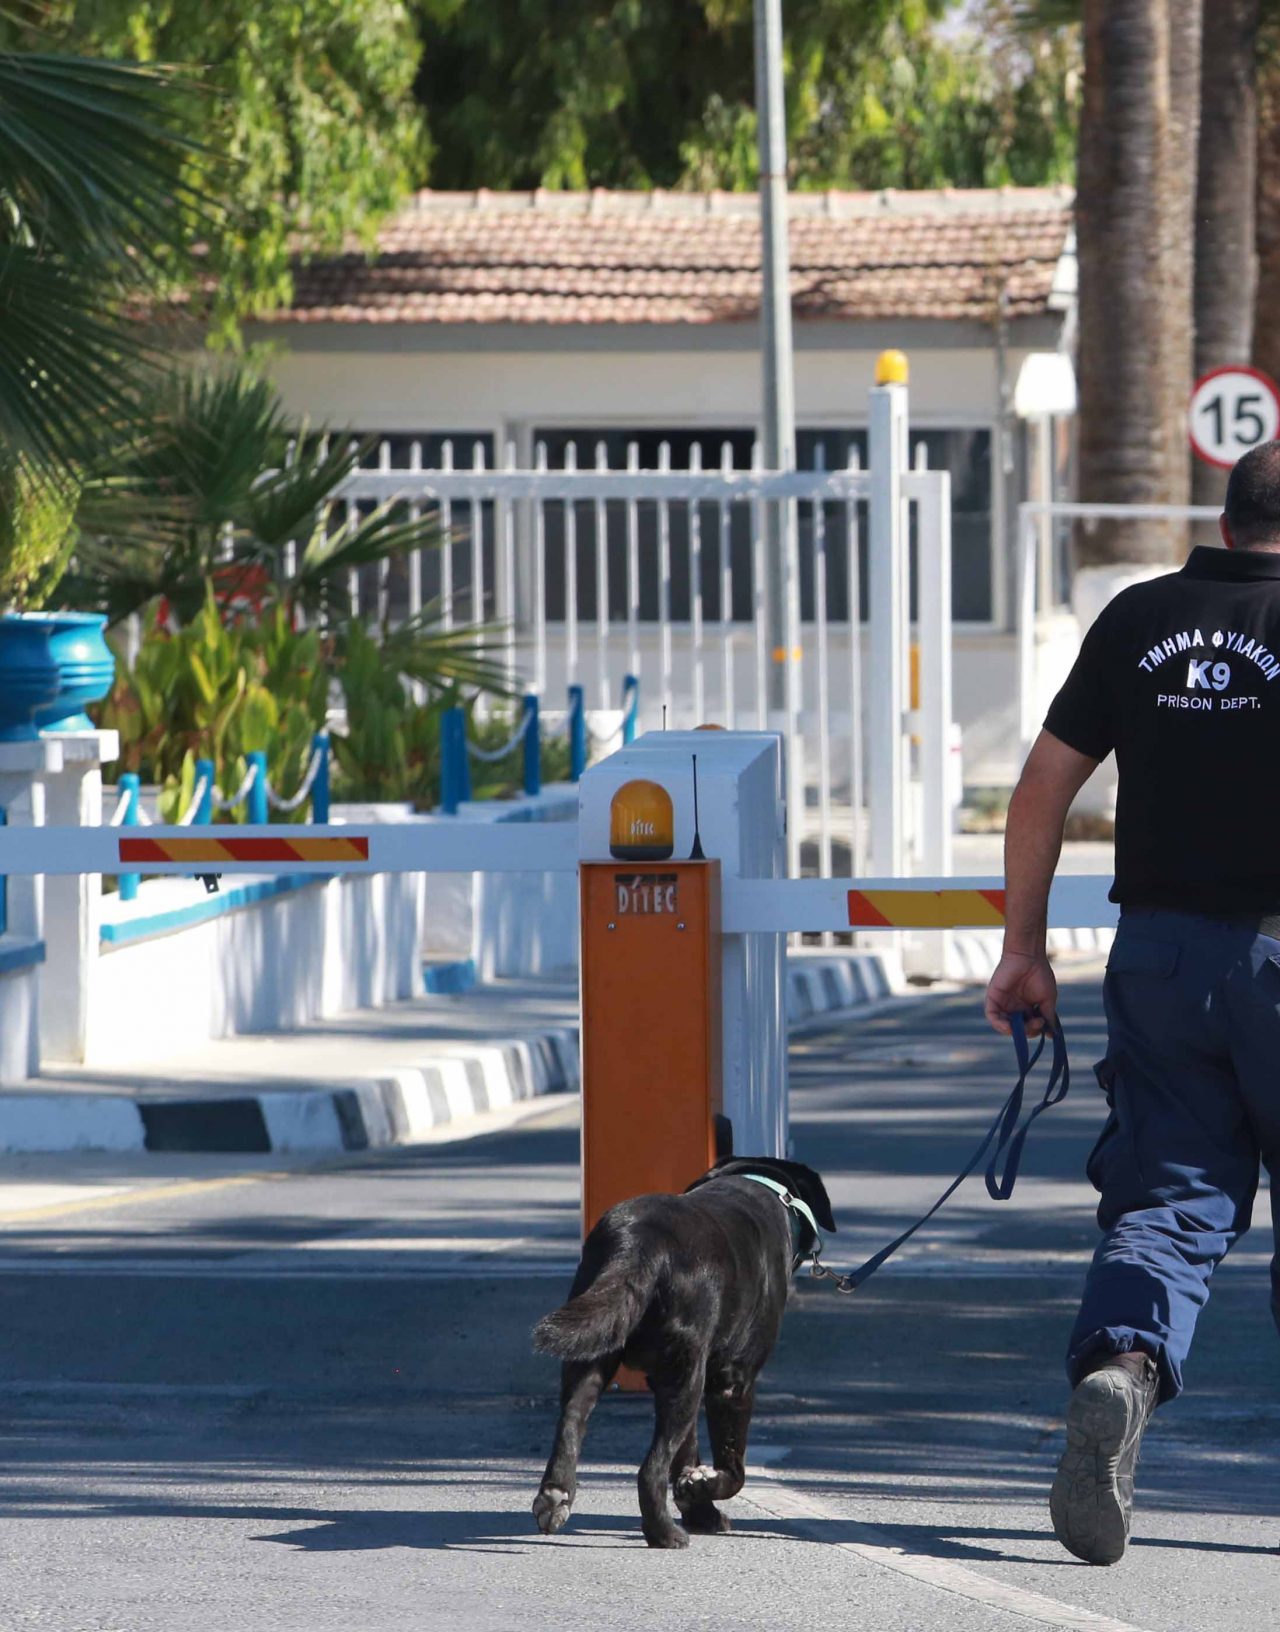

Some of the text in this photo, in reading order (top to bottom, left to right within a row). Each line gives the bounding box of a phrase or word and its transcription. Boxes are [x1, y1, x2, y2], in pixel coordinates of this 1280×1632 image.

[1202, 396, 1264, 446] 15
[1138, 628, 1205, 673] ΤΜΗΜΑ
[1186, 658, 1231, 691] K9
[1157, 694, 1261, 711] PRISON DEPT.
